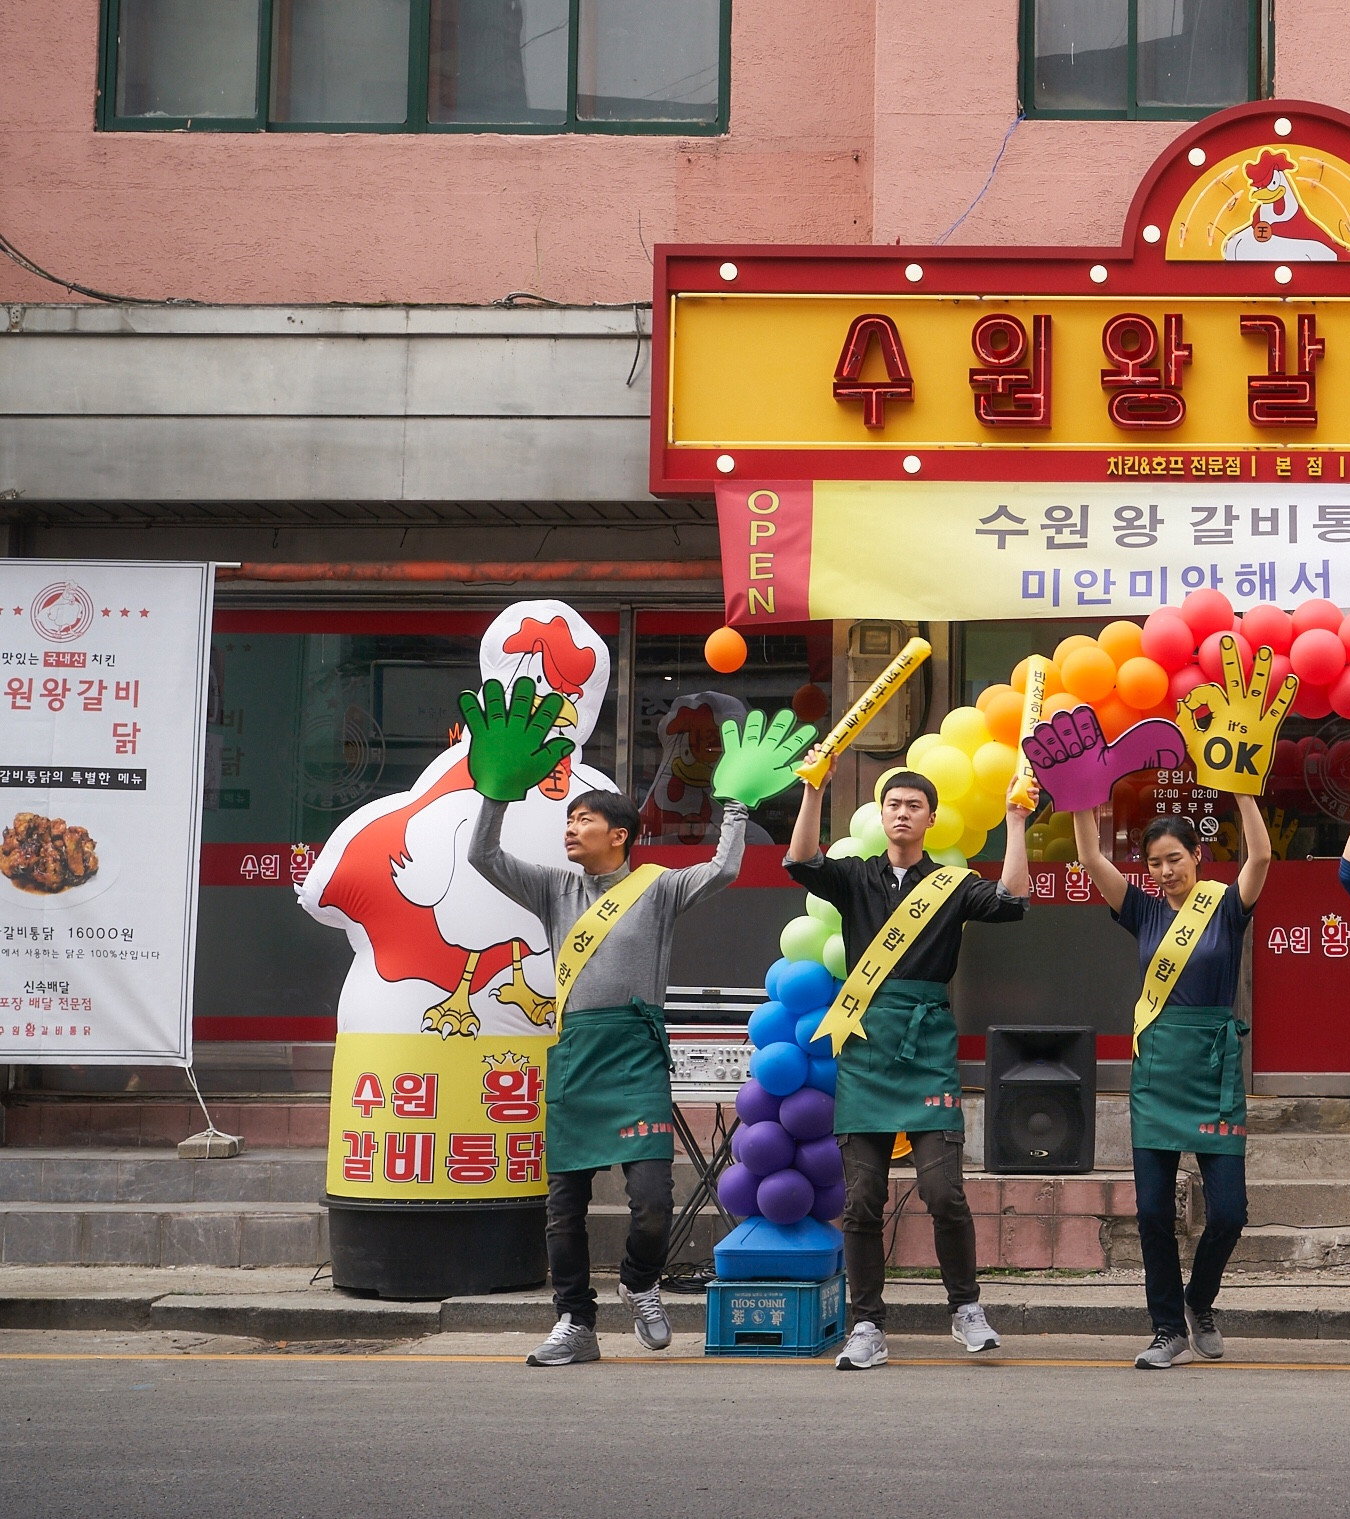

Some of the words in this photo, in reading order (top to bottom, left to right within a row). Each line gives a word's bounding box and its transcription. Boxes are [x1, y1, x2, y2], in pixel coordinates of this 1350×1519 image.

[1107, 456, 1184, 476] 치킨&호프
[1190, 456, 1242, 476] 전문점
[746, 489, 780, 616] OPEN
[1021, 559, 1332, 608] 미안미안해서
[2, 652, 39, 666] 맛있는
[45, 653, 85, 667] 국내산
[91, 654, 116, 667] 치킨
[4, 678, 140, 712] 원왕갈비
[1228, 720, 1248, 734] it's
[112, 722, 141, 754] 닭
[1203, 736, 1264, 776] OK
[0, 770, 63, 784] 갈비통닭의
[70, 771, 111, 785] 특별한
[117, 772, 143, 785] 메뉴
[1153, 789, 1178, 798] 12:00
[1191, 789, 1218, 799] 02:00
[240, 854, 280, 879] 수원
[0, 926, 54, 940] 갈비통닭
[1268, 927, 1310, 954] 수원
[1320, 921, 1350, 958] 왕
[25, 949, 60, 959] 사용하는
[65, 949, 85, 959] 닭은
[91, 950, 161, 960] 100%산입니다
[841, 872, 953, 1018] 반성합니다
[23, 981, 70, 994] 신속배달
[0, 997, 23, 1011] 포장
[29, 997, 53, 1011] 배달
[58, 997, 92, 1011] 전문점
[351, 1072, 439, 1118] 수원
[481, 1065, 544, 1123] 왕
[342, 1130, 546, 1184] 갈비통닭
[731, 1298, 756, 1309] SOJU
[758, 1298, 786, 1308] JINRO
